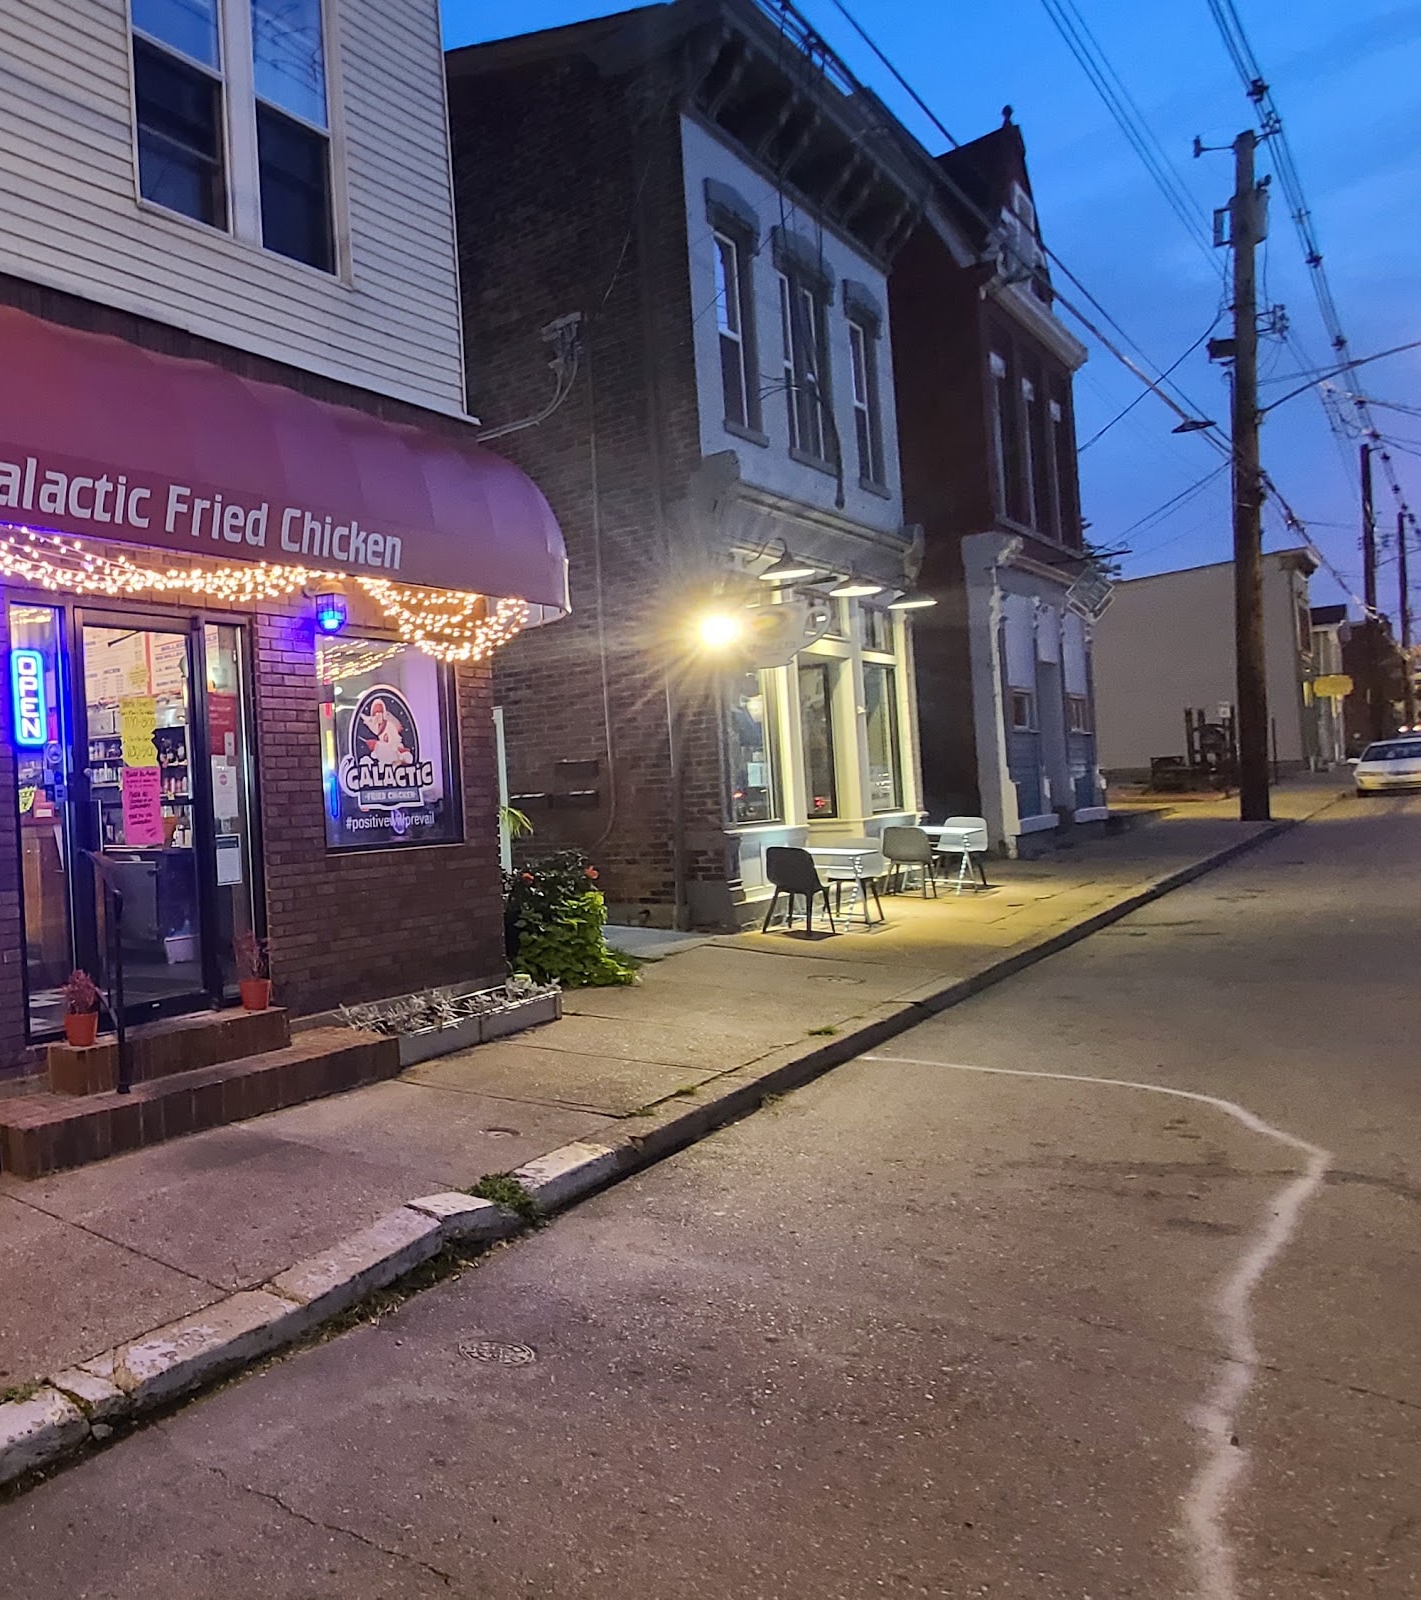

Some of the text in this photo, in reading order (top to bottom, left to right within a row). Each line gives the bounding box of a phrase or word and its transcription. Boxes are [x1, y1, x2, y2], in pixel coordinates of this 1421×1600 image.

[165, 485, 269, 548] Fried
[281, 507, 402, 570] Chicken
[17, 656, 43, 739] OPEN
[346, 811, 435, 833] #positivelprevail
